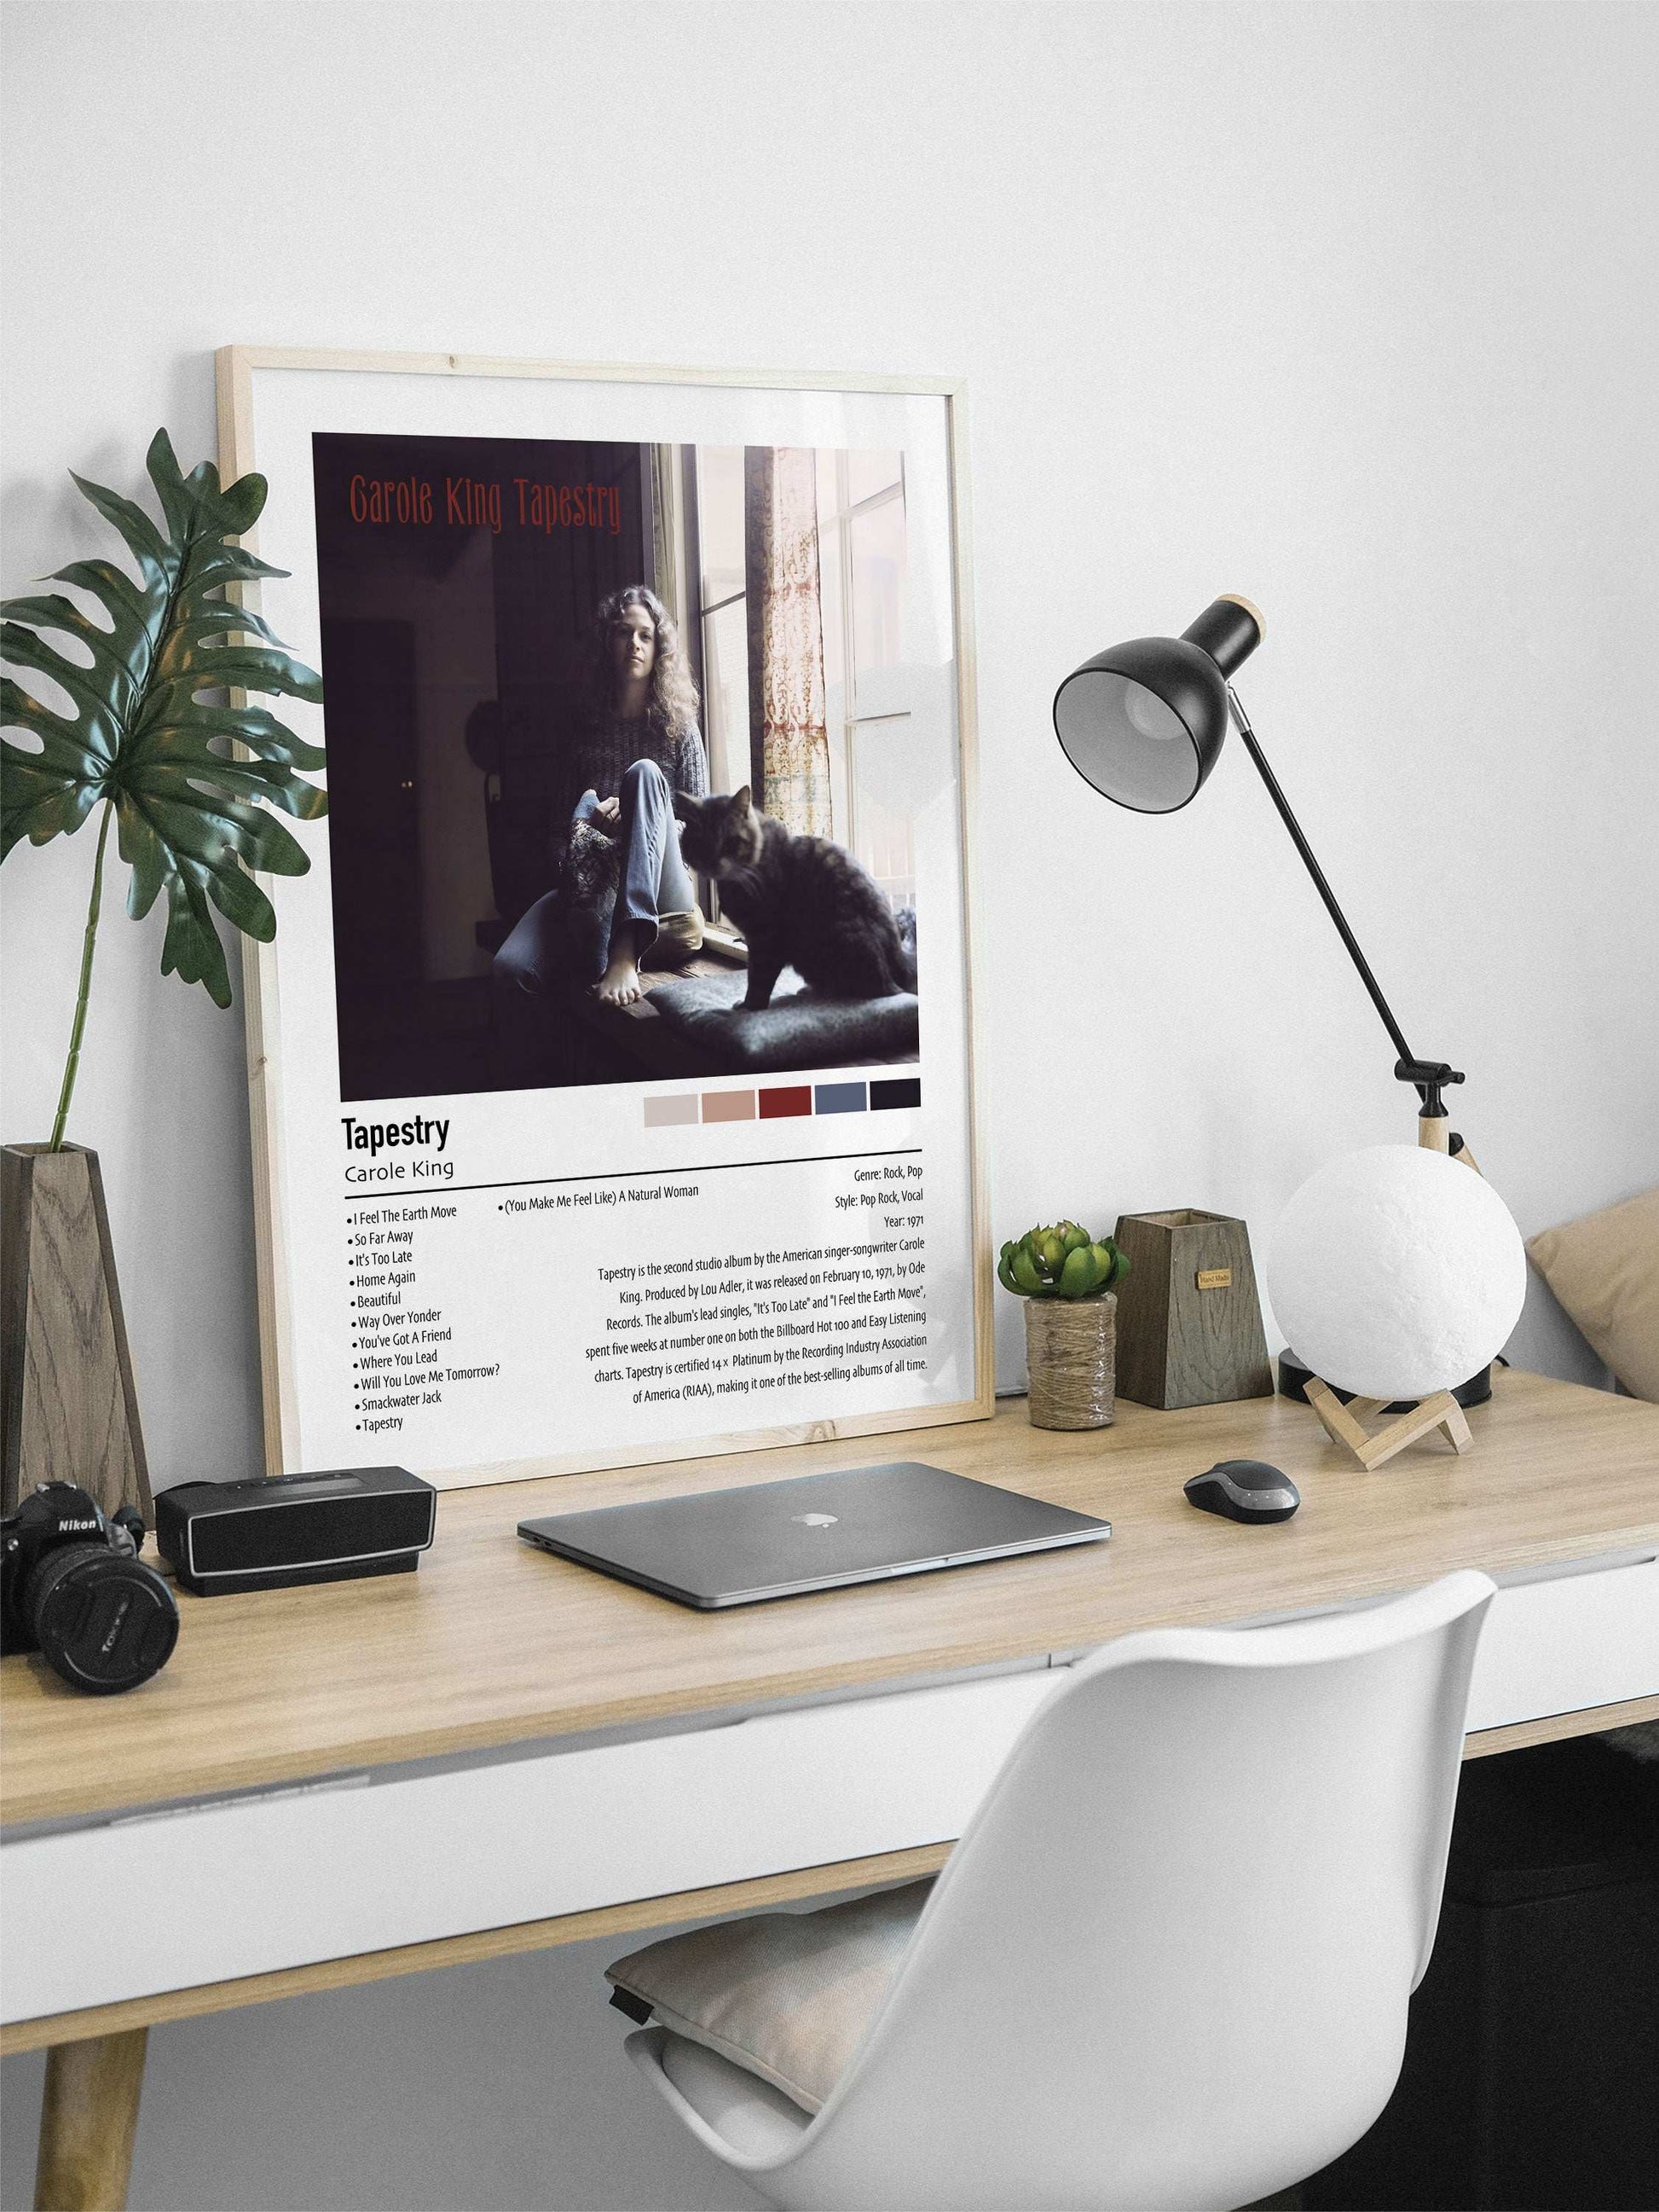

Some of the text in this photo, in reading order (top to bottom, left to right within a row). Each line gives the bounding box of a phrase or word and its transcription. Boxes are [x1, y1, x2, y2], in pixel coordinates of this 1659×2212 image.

[350, 474, 620, 535] Carole King Tapestry
[340, 1115, 450, 1157] Tapestry
[344, 1160, 454, 1183] Carole King
[853, 1165, 923, 1182] Genre: Rock, Pop
[505, 1185, 699, 1215] (You Make Me Feel Like) A Natural Woman
[835, 1187, 923, 1211] Style: Pop Rock, Vocal
[360, 1209, 379, 1225] Feel
[381, 1208, 400, 1224] The
[402, 1206, 429, 1222] Earth
[431, 1206, 457, 1219] Move
[883, 1215, 924, 1229] Year: 1971
[355, 1230, 413, 1247] So Far Away
[356, 1251, 413, 1267] It's Too Late
[597, 1236, 925, 1283] Tapestry is the second studio album by the American singer-songwriter Carole
[356, 1270, 416, 1288] Home Again
[619, 1260, 926, 1306] King. Produced by Lou Adler, it was released on February 10, 1971, by Ode
[357, 1290, 402, 1309] Beautiful
[606, 1285, 927, 1331] Records. The album's lead singles, "It's Too Late" and "I Feel the Earth Move",
[357, 1308, 442, 1331] Way Over Yonder
[358, 1326, 452, 1350] You've Got A Friend
[585, 1310, 927, 1362] spent five weeks at number one on both the Billboard Hot 100 and Easy Listening
[359, 1348, 437, 1370] Where You Lead
[594, 1335, 928, 1383] charts. Tapestry is certified 14 x Platinum by the Recording Industry Association
[361, 1363, 500, 1391] Will You Love Me Tomorrow?
[633, 1358, 928, 1404] of America (RIAA), making it one of the best-selling albums of all time.
[361, 1389, 442, 1411] Smackwater Jack
[361, 1416, 403, 1434] Tapestry
[58, 1520, 96, 1532] Nikon
